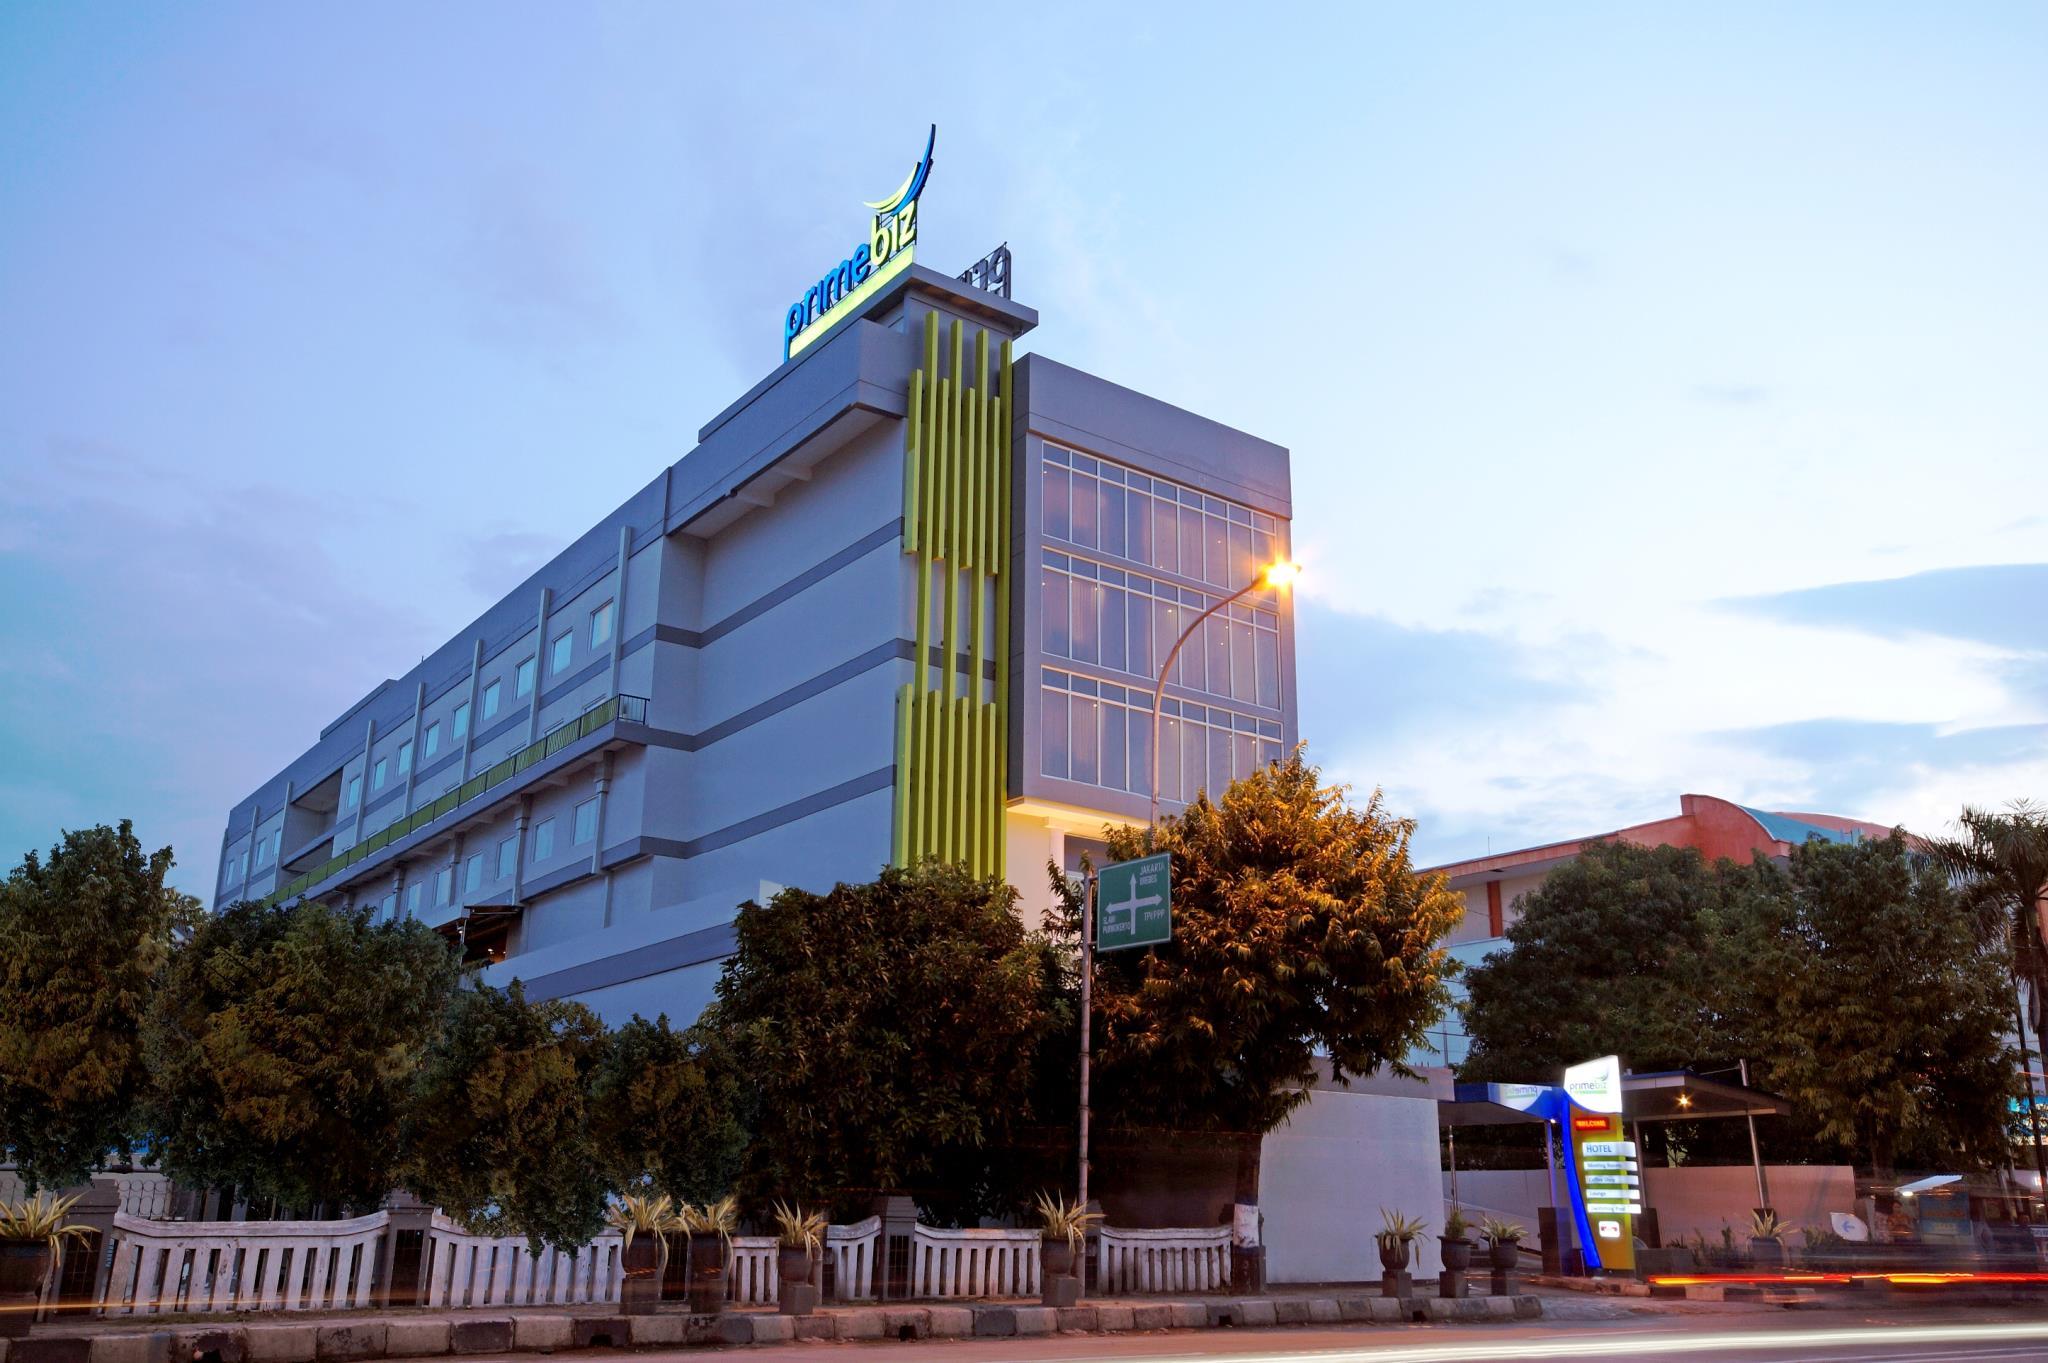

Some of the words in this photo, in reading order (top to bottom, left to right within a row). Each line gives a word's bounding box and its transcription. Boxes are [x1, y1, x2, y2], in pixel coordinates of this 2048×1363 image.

[784, 200, 916, 362] primebiz
[1140, 863, 1165, 875] JAKARTA
[1586, 1145, 1612, 1153] HOTEL
